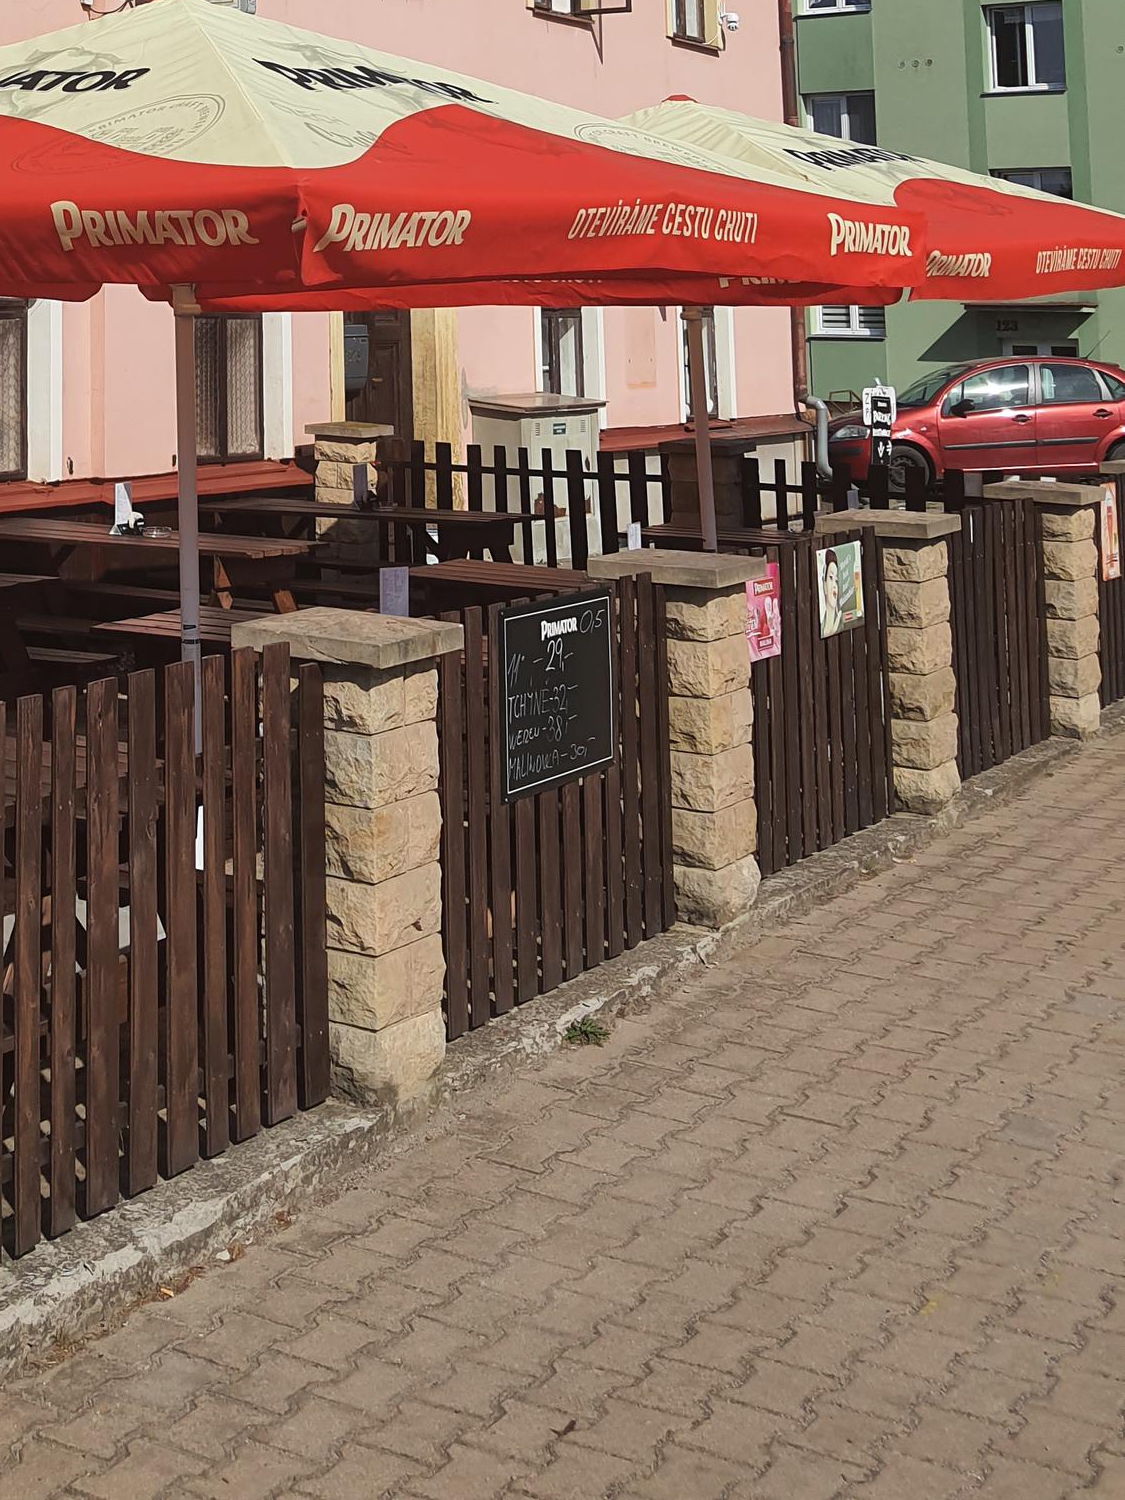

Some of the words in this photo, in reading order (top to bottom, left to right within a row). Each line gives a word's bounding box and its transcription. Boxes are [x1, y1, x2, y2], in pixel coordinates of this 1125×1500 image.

[252, 57, 498, 104] PRIMAOR
[51, 200, 259, 252] PRIMATOR
[313, 203, 472, 253] PRIMATOR
[568, 198, 664, 240] OTEVÍRÁME
[662, 202, 713, 239] CESTU
[714, 209, 759, 244] CHUTI
[827, 211, 914, 257] PRIMATOR
[926, 249, 992, 278] PRIMATOR
[1077, 247, 1101, 270] CESTU
[1098, 248, 1123, 271] CHUTI
[996, 319, 1019, 332] 123
[541, 616, 578, 641] PRIMATOR
